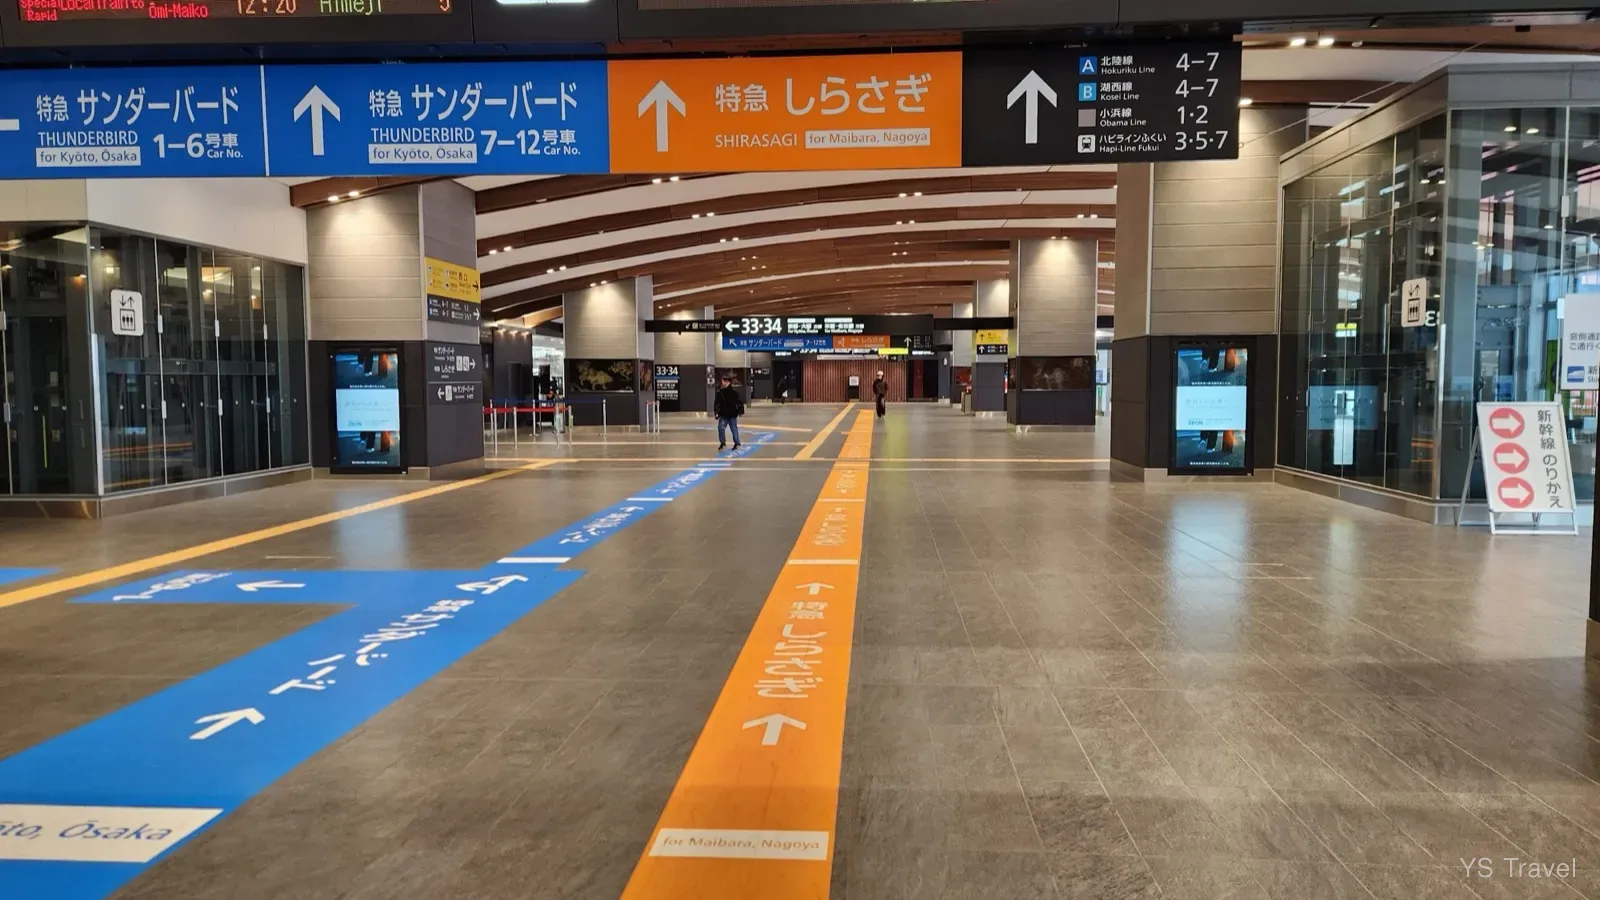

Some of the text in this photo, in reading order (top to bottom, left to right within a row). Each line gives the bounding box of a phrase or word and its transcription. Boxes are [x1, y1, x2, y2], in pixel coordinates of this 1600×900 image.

[27, 10, 58, 21] Rapid
[1082, 59, 1095, 73] A
[1100, 56, 1133, 66] 北陸線
[1101, 66, 1155, 75] Hokuriku Line
[715, 73, 932, 116] 特急 しらさぎ
[1083, 86, 1093, 99] B
[1100, 82, 1133, 92] 湖西線
[1100, 93, 1121, 101] Kosei
[36, 86, 239, 125] 特急 サンダーバード
[369, 81, 577, 121] 特急 サンダーバード
[1100, 108, 1132, 118] 小浜線
[38, 131, 138, 147] THUNDERBIRD
[371, 127, 474, 143] THUNDERBIRD
[715, 133, 797, 148] SHIRASAGI
[809, 131, 928, 145] for Maibara, Nagoya
[1099, 133, 1167, 144] ハピラインふくい
[207, 149, 244, 158] Car No.
[373, 145, 473, 161] for Kyōto, Ōsaka
[544, 146, 581, 155] Car No.
[1100, 144, 1160, 154] Hapi-Line Fukui
[40, 149, 137, 166] for Kyōto, Ōsaka
[754, 623, 828, 698] しらさぎ
[59, 820, 172, 840] Ōsaka
[663, 836, 819, 851] for Maibara, Nagoya
